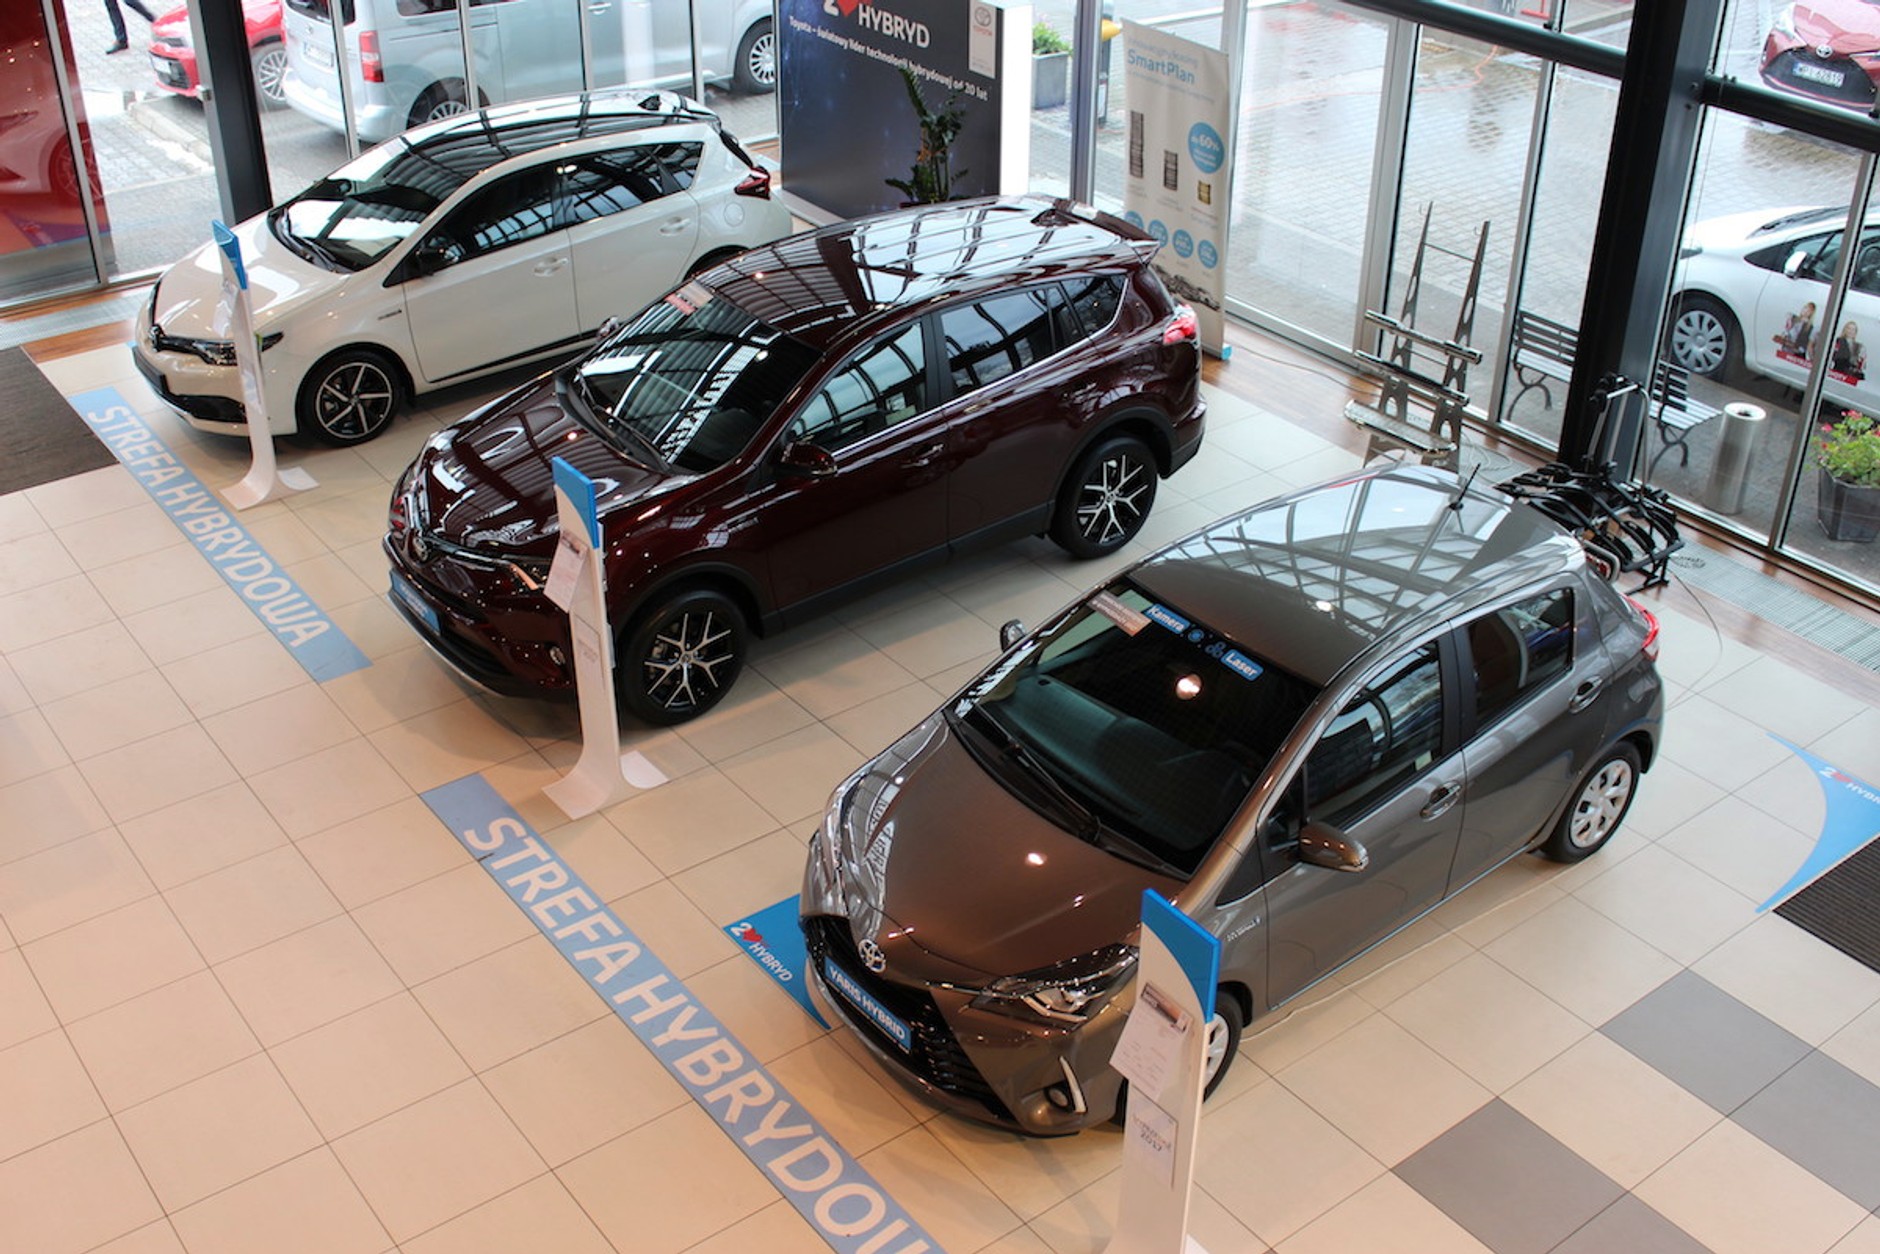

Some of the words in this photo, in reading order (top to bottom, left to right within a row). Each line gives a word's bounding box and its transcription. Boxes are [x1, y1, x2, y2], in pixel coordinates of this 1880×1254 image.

[858, 3, 930, 48] HYBRYD
[789, 15, 811, 34] Toyota
[817, 26, 849, 50] światowy
[849, 38, 866, 54] lider
[866, 46, 908, 69] technologii
[908, 60, 953, 89] hybrydowej
[953, 77, 964, 90] od
[964, 81, 976, 96] 20
[976, 85, 989, 101] lat
[1127, 48, 1195, 84] SmartPlan
[88, 404, 185, 488] STREFA
[156, 481, 330, 648] HYBRYDOWA
[1148, 605, 1185, 632] Kamera
[1225, 652, 1257, 677] Laser
[1819, 766, 1837, 779] 2
[463, 816, 641, 985] STREFA
[730, 921, 752, 938] 2
[749, 942, 793, 982] HYBRYD
[829, 966, 862, 1002] YARIS
[862, 995, 906, 1040] HYBRID
